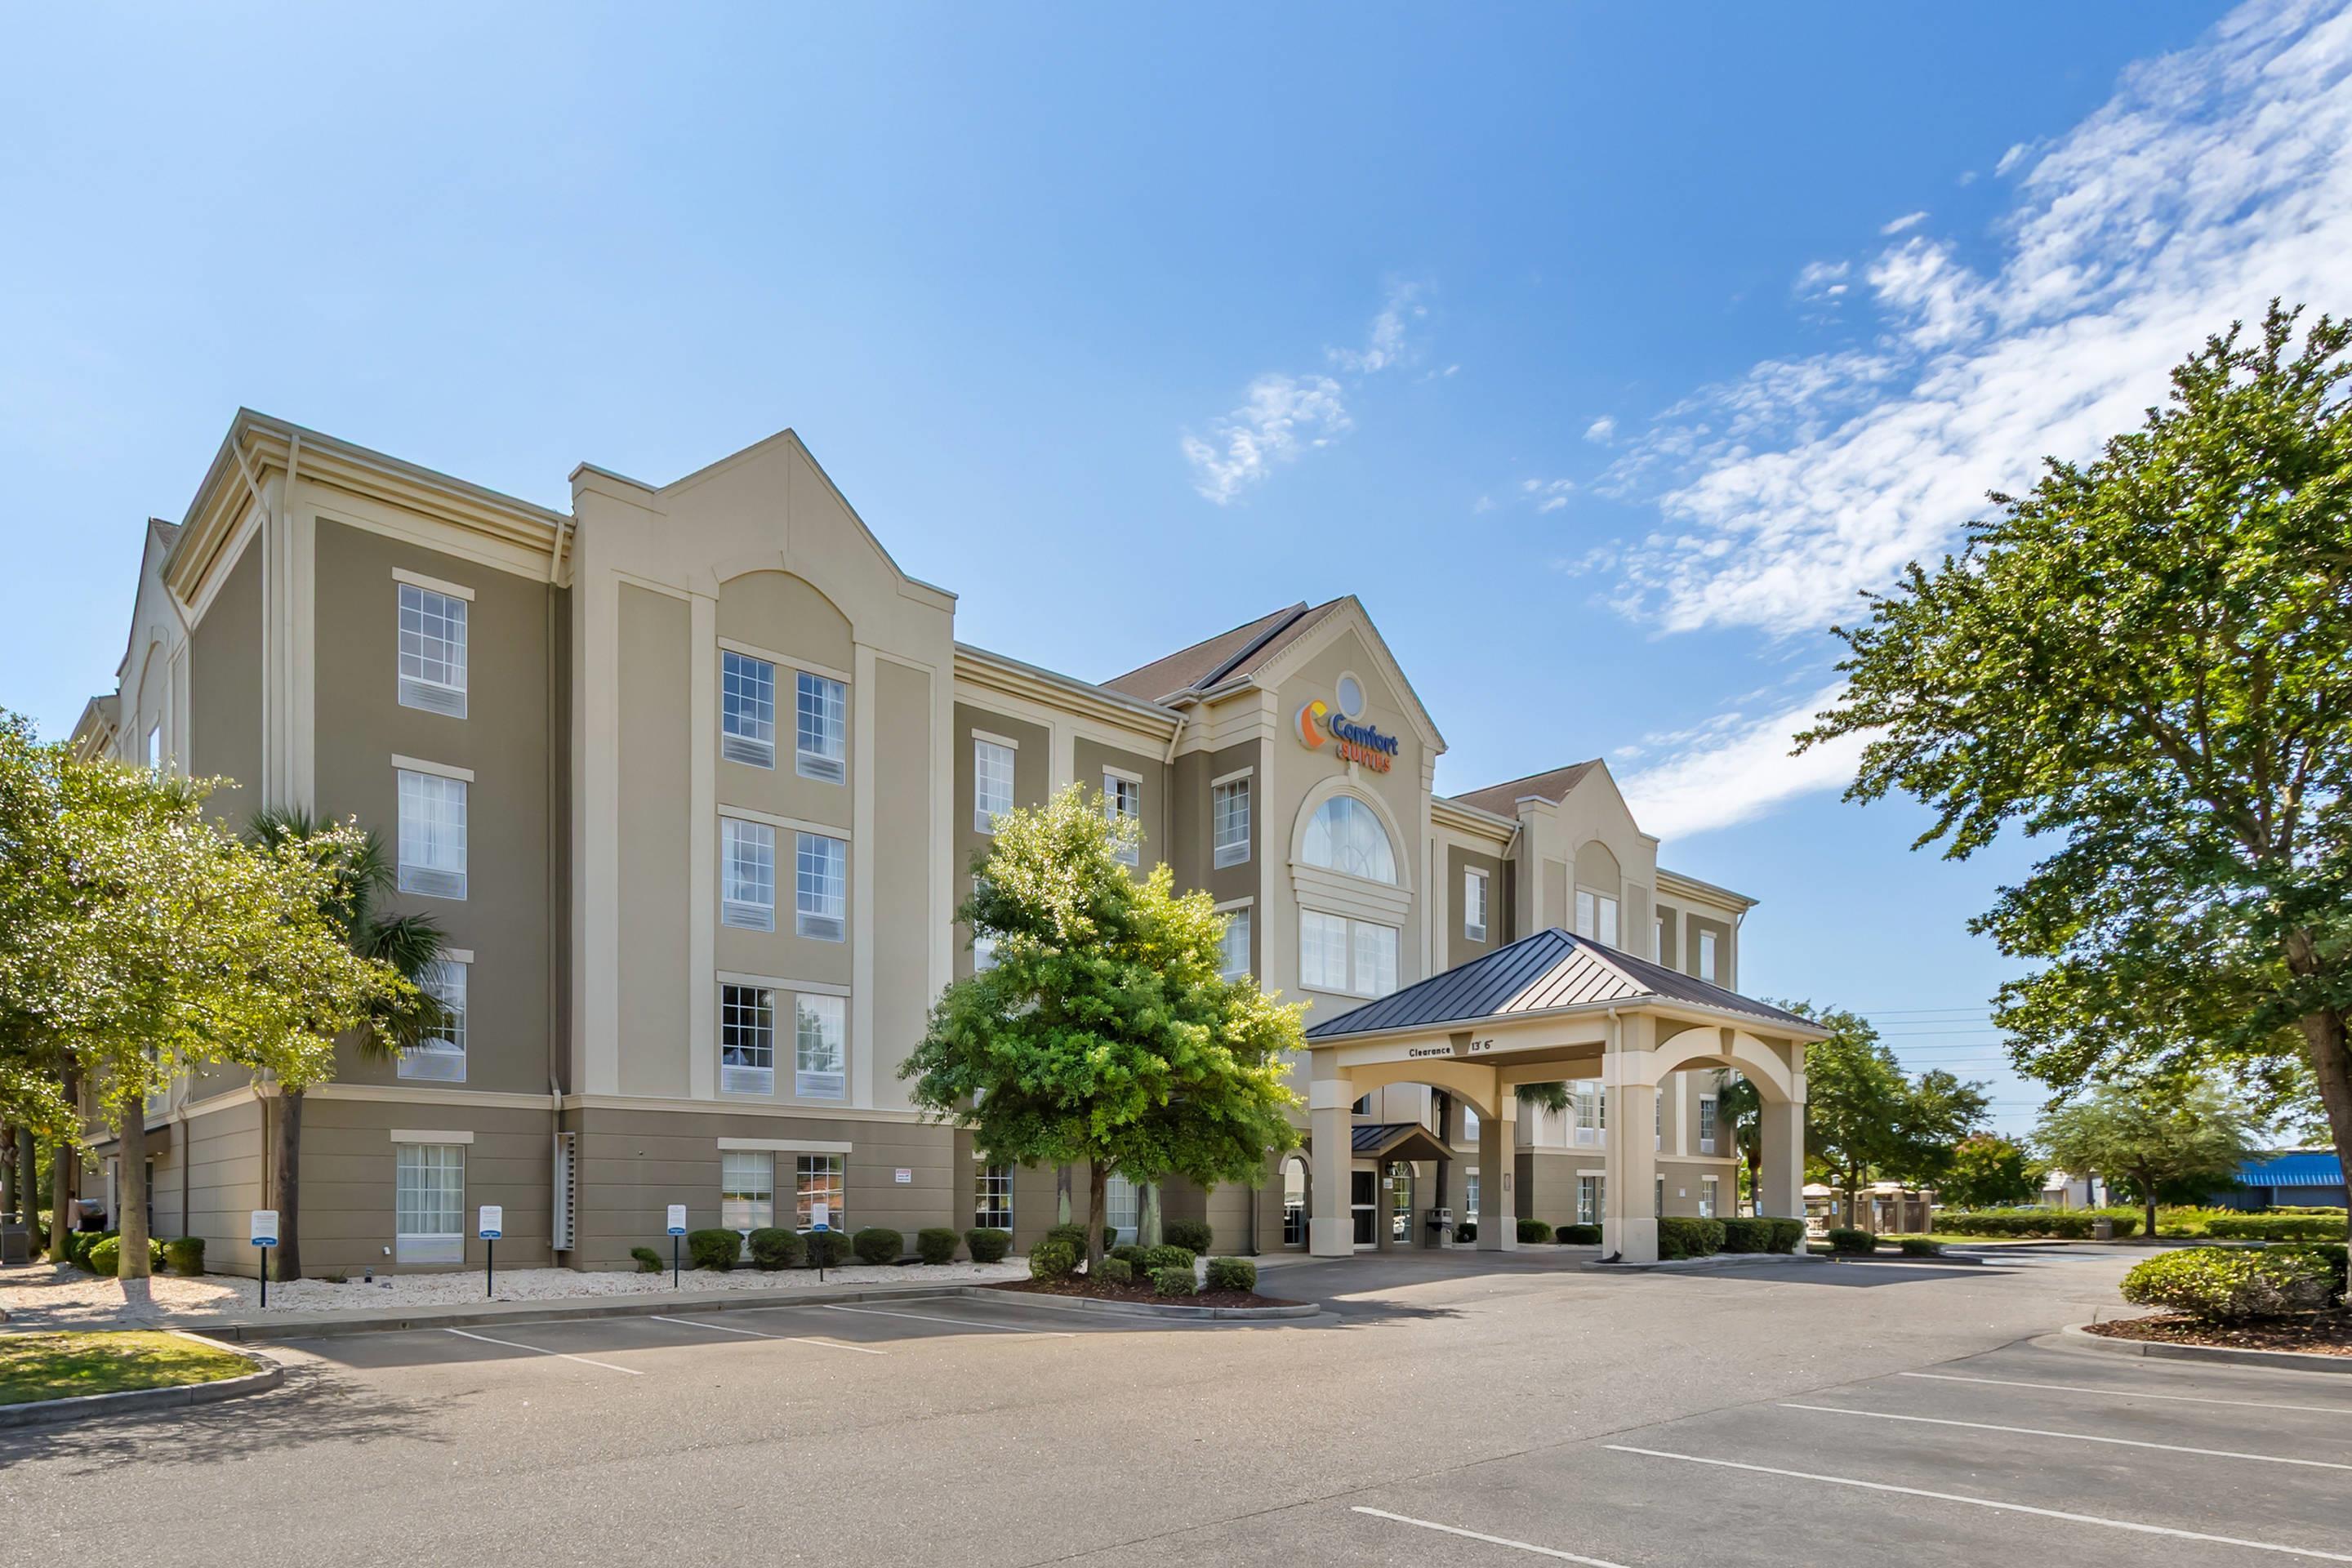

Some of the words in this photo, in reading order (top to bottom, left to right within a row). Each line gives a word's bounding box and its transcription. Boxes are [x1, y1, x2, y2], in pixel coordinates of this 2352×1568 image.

[1332, 713, 1399, 756] Comfort
[1341, 741, 1391, 773] SUITES
[1409, 1047, 1451, 1058] Clearance
